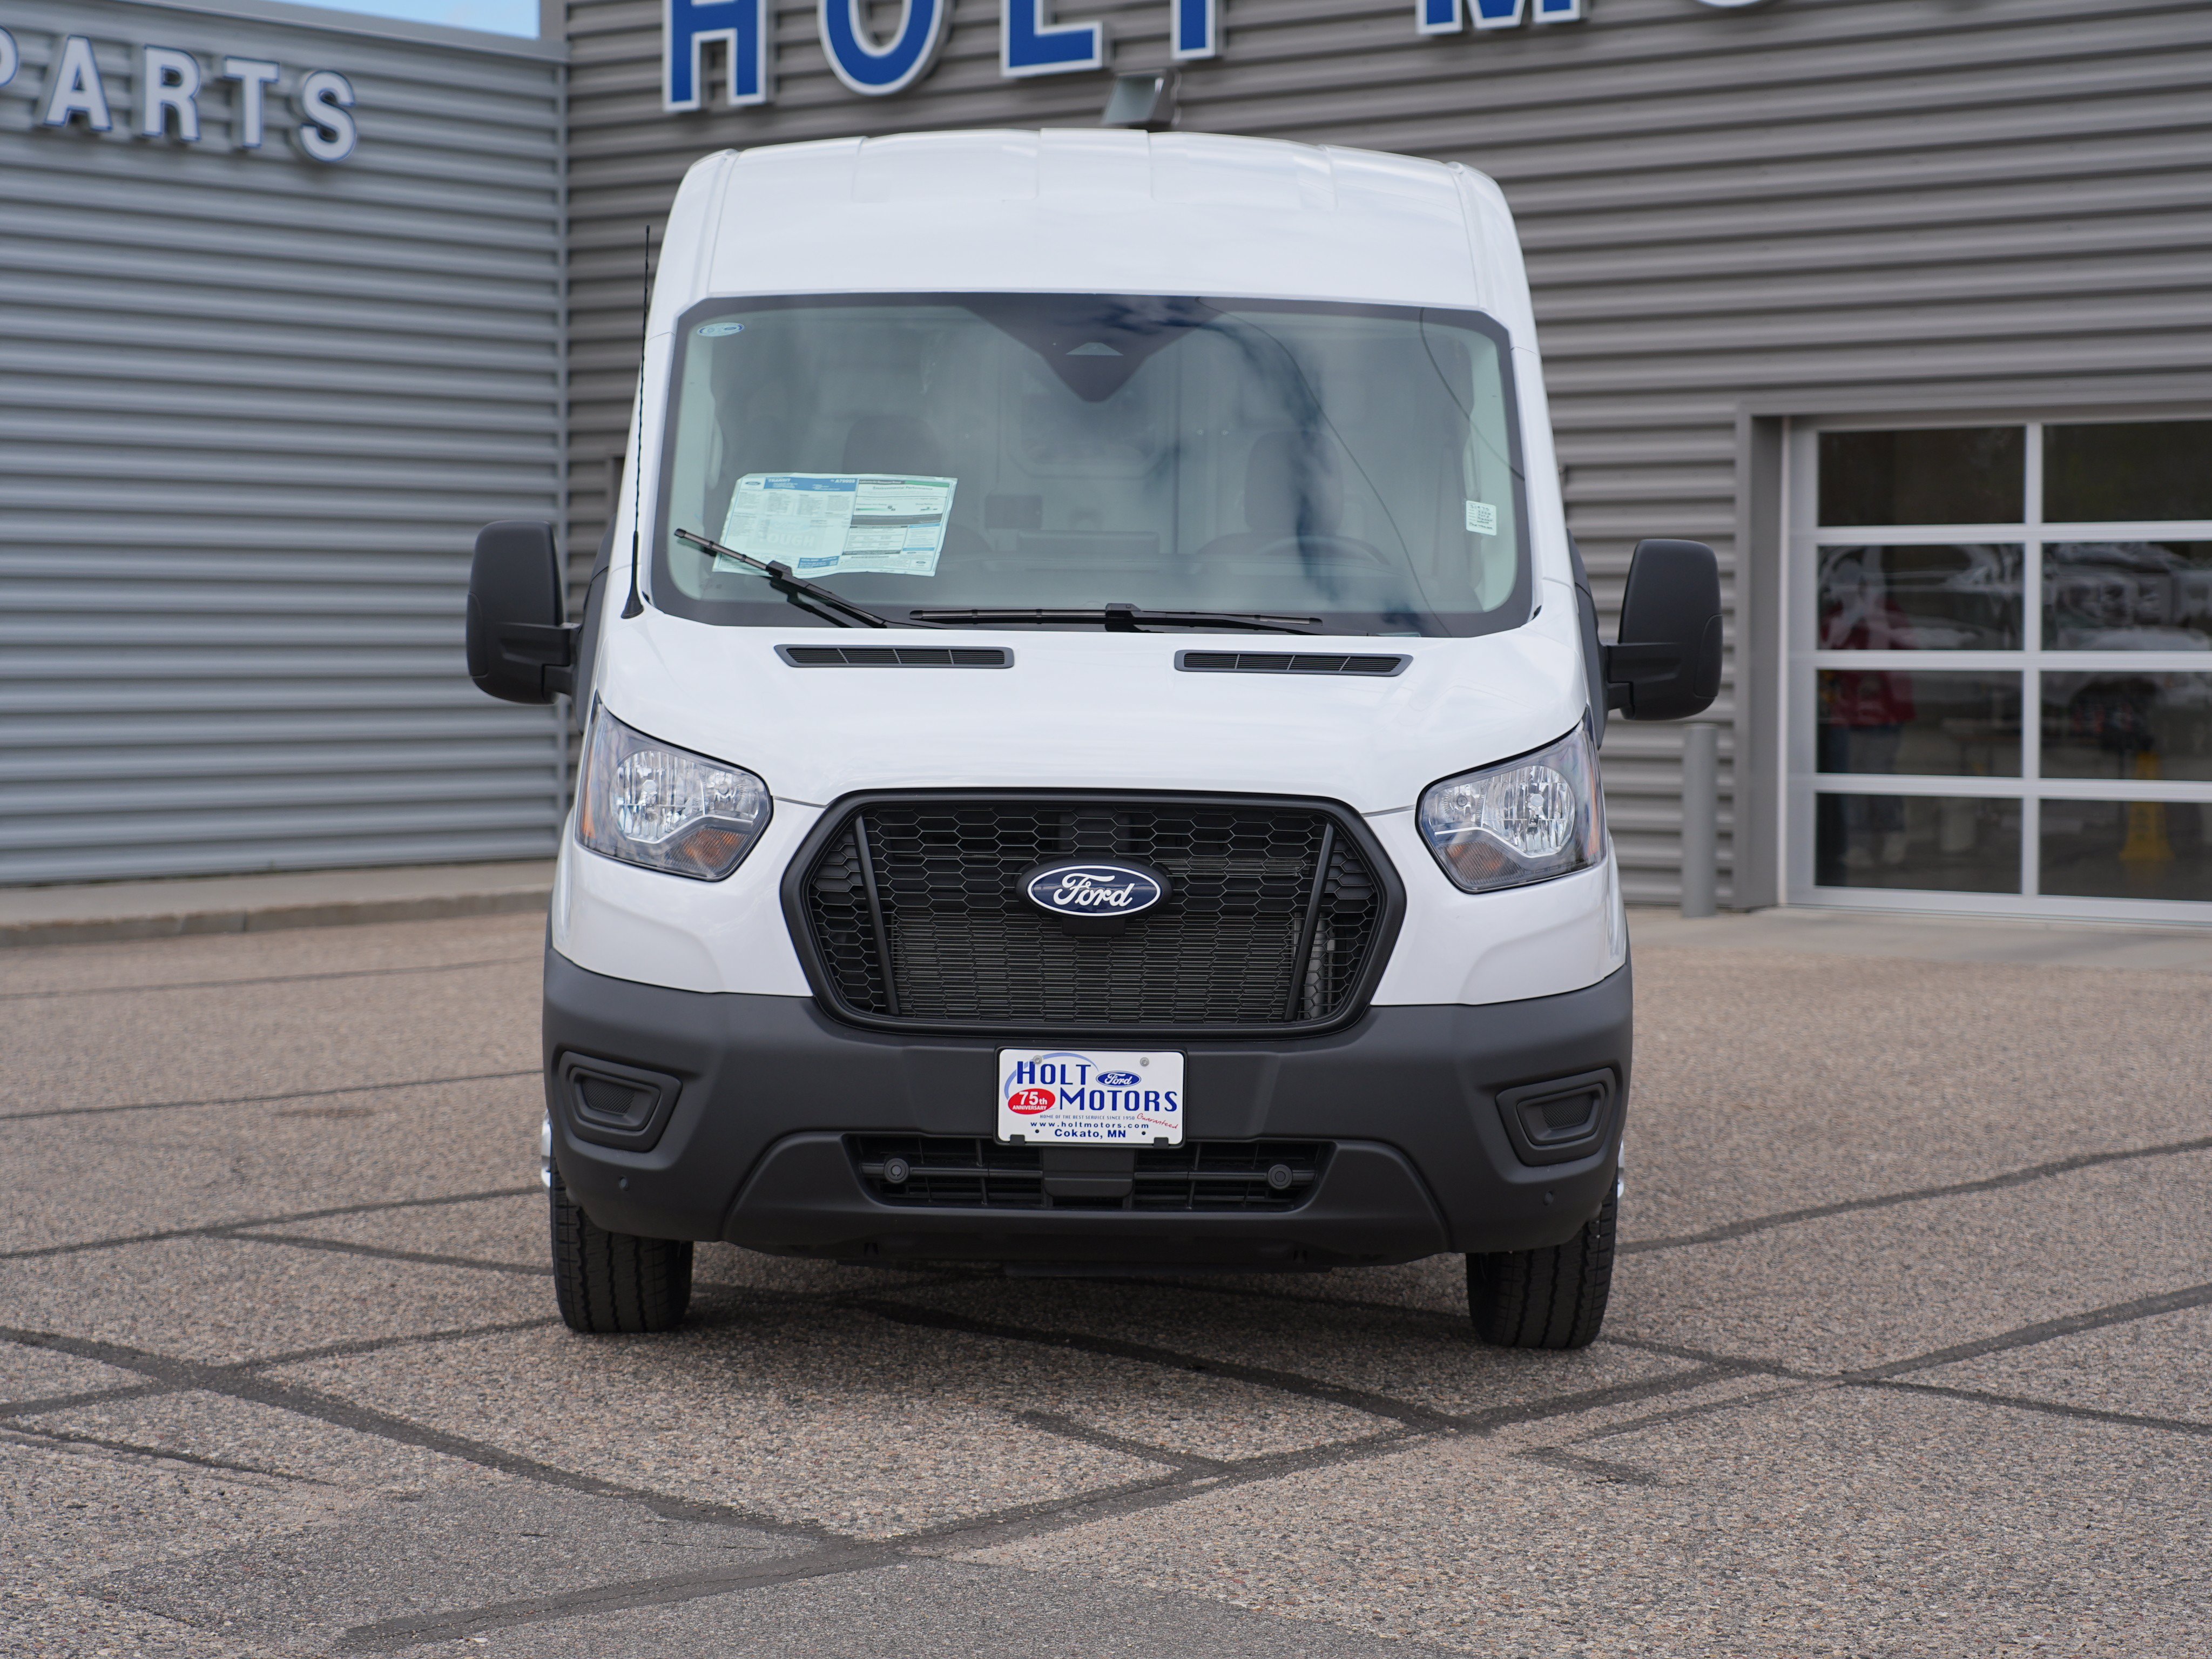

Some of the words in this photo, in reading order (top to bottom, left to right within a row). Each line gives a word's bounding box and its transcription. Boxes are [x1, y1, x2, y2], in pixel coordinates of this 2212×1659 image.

[1053, 873, 1135, 907] Ford
[1017, 1061, 1091, 1085] HOLT
[1104, 1073, 1132, 1085] Ford
[1019, 1091, 1048, 1105] 75th
[1060, 1087, 1177, 1111] MOTORS
[1137, 1112, 1178, 1129] Guaranteed
[1055, 1129, 1102, 1139] Cokato,
[1108, 1130, 1125, 1138] MN
